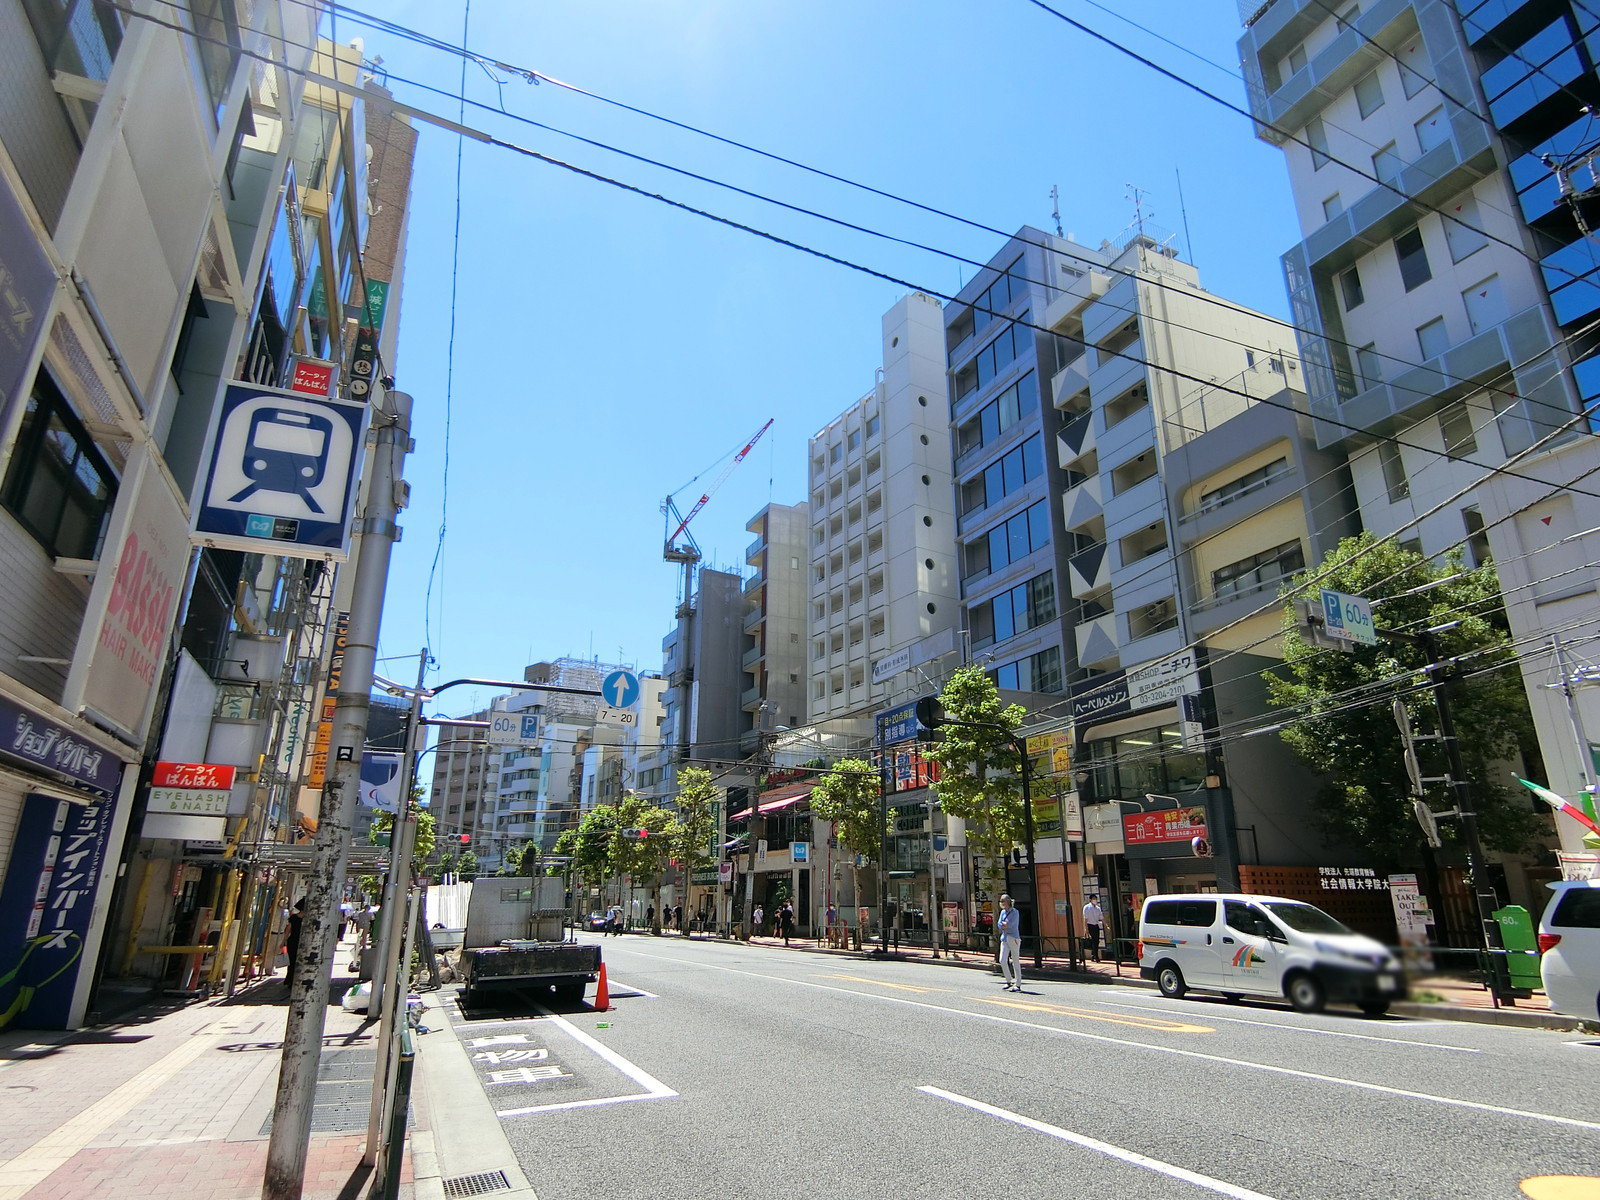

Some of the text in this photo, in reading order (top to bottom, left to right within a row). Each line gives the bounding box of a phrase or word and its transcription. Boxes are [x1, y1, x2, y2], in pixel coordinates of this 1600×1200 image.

[300, 369, 327, 381] ケータイ
[107, 531, 173, 661] BASSA
[1328, 595, 1337, 614] P
[1345, 603, 1369, 627] 60分
[100, 621, 158, 688] HAIR MAKE
[1161, 656, 1191, 675] ニチワ
[1075, 690, 1127, 713] ヘーベルメゾン
[1140, 685, 1186, 705] 03-3204-2101
[494, 717, 516, 732] 60分
[525, 718, 535, 730] P
[14, 713, 103, 780] ショップインバース
[175, 764, 217, 776] ケータイ
[153, 790, 225, 803] EYELASH
[169, 801, 222, 812] & NAIL
[896, 816, 925, 832] COFFE
[1319, 867, 1342, 876] 学校法人
[464, 1033, 573, 1086] 貨物車
